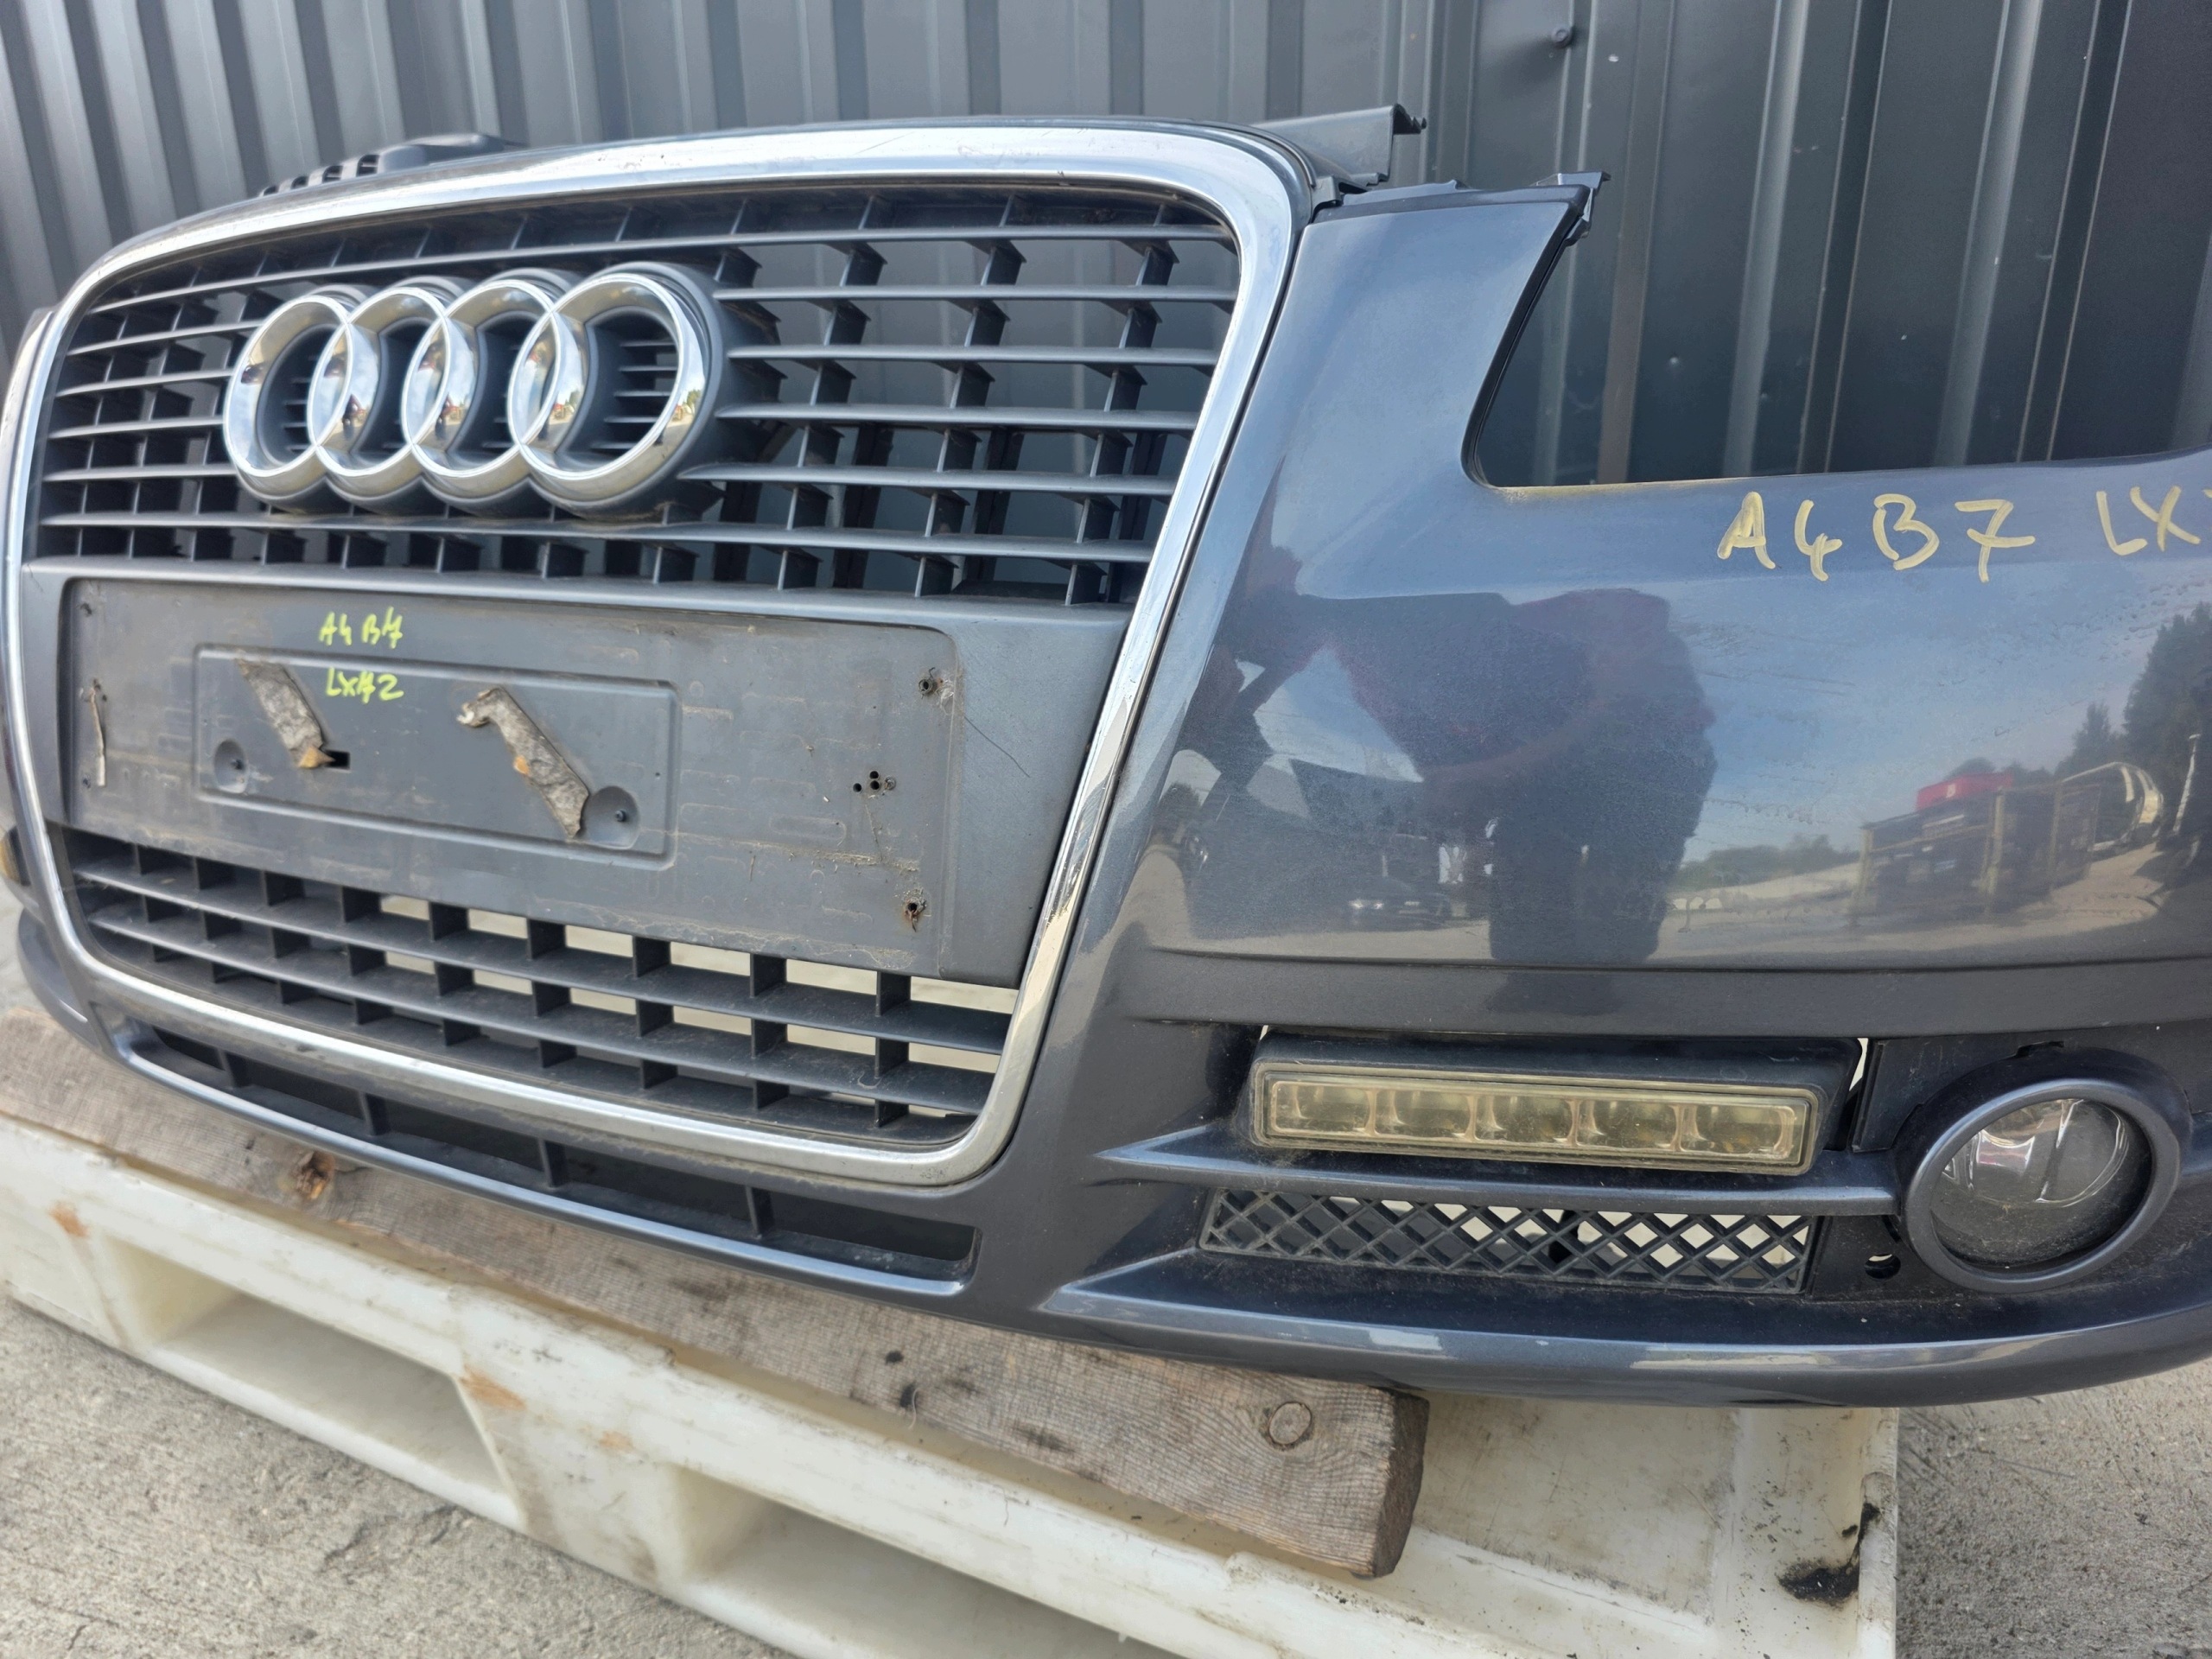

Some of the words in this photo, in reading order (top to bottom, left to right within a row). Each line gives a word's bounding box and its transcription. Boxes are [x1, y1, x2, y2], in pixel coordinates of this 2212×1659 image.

[1717, 491, 1843, 582] A4
[1872, 493, 2036, 582] B7
[2095, 485, 2212, 556] LX
[319, 612, 353, 646] A4
